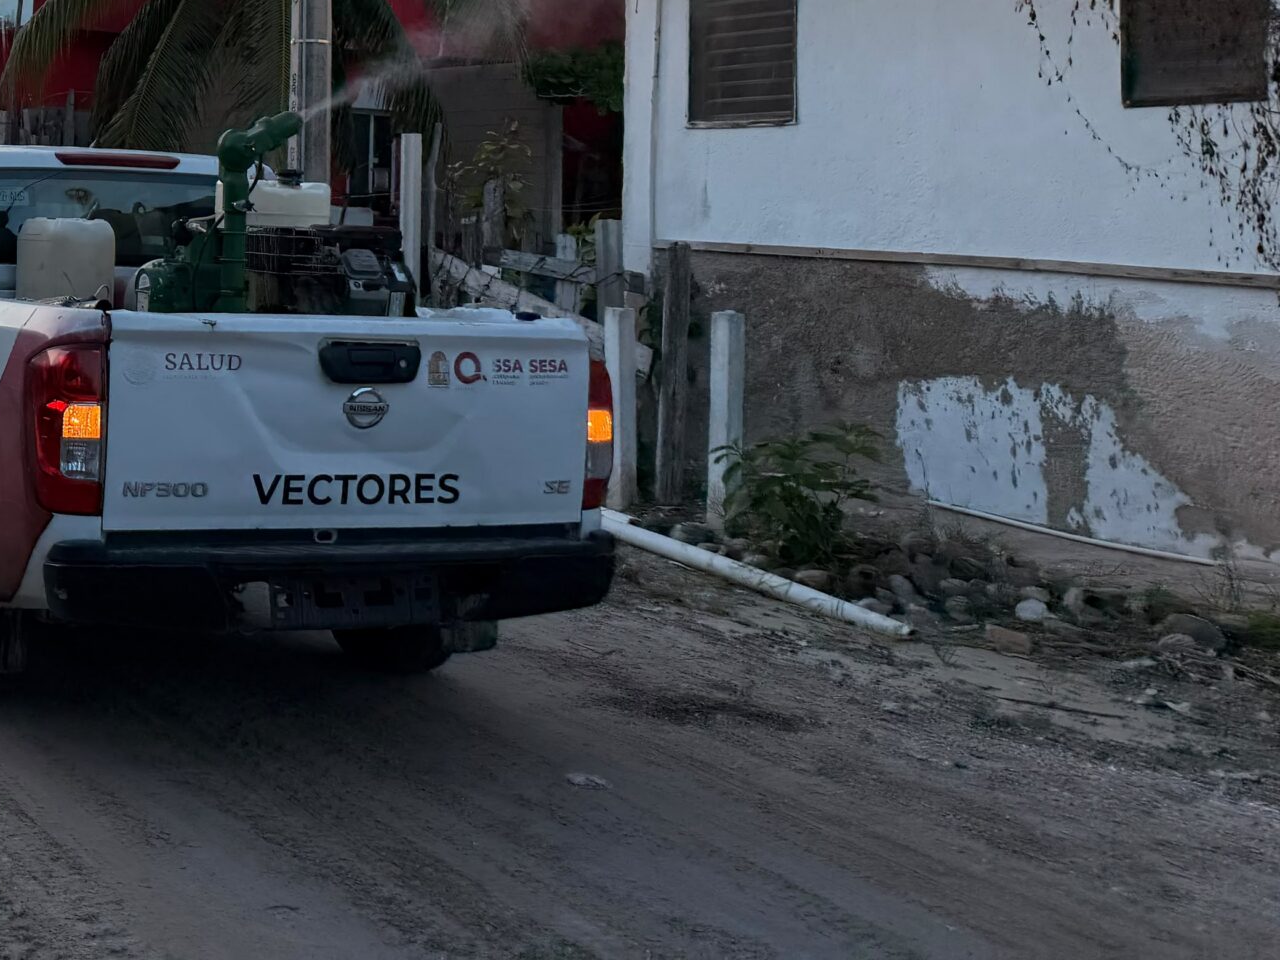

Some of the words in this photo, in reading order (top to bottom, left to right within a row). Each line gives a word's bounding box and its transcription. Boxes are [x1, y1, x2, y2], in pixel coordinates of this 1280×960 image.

[165, 352, 243, 371] SALUD
[492, 358, 524, 374] SSA
[528, 358, 568, 374] SESA
[348, 404, 385, 413] NISSAN
[122, 481, 209, 498] NP300
[252, 472, 461, 506] VECTORES
[543, 479, 571, 495] SE
